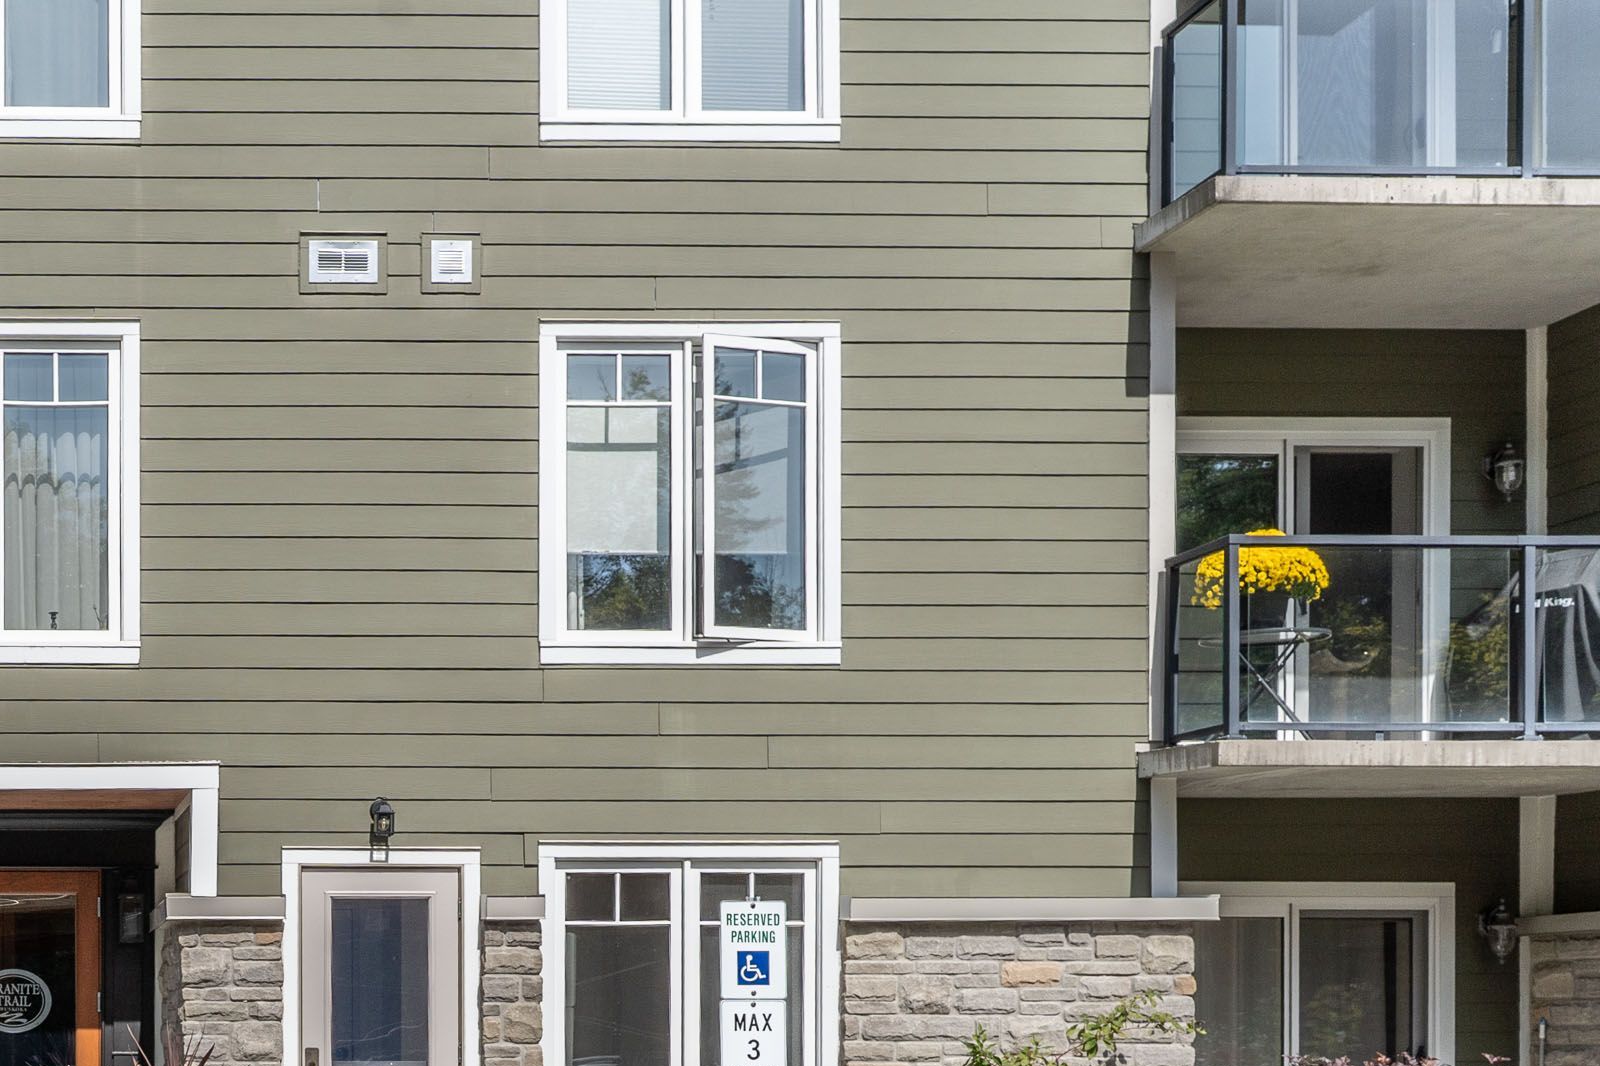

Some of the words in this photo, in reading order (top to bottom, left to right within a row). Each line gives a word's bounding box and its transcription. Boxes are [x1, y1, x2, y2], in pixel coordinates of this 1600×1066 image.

[726, 913, 780, 926] RESERVED
[731, 930, 776, 943] PARKING
[734, 1013, 772, 1031] MAX
[747, 1039, 760, 1060] 3
